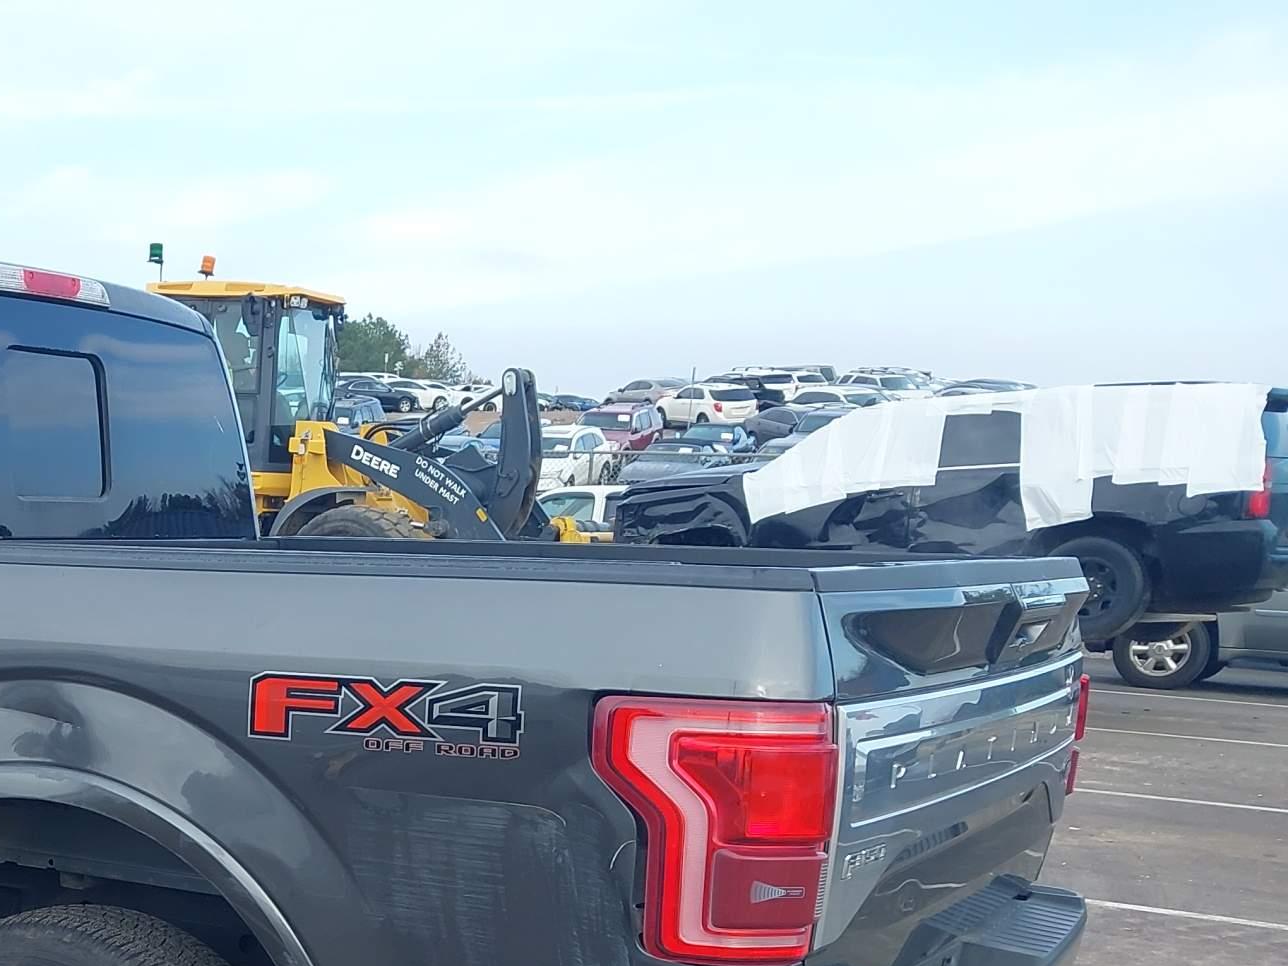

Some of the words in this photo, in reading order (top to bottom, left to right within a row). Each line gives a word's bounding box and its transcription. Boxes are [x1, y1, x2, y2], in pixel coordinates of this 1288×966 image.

[351, 445, 400, 479] DEERE
[416, 456, 428, 469] DO
[429, 465, 445, 480] NOT
[446, 477, 467, 499] WALK
[415, 469, 439, 491] UNDER
[439, 487, 460, 505] MAST
[248, 671, 524, 746] FX4
[363, 738, 424, 753] OFF
[435, 743, 520, 760] ROAD
